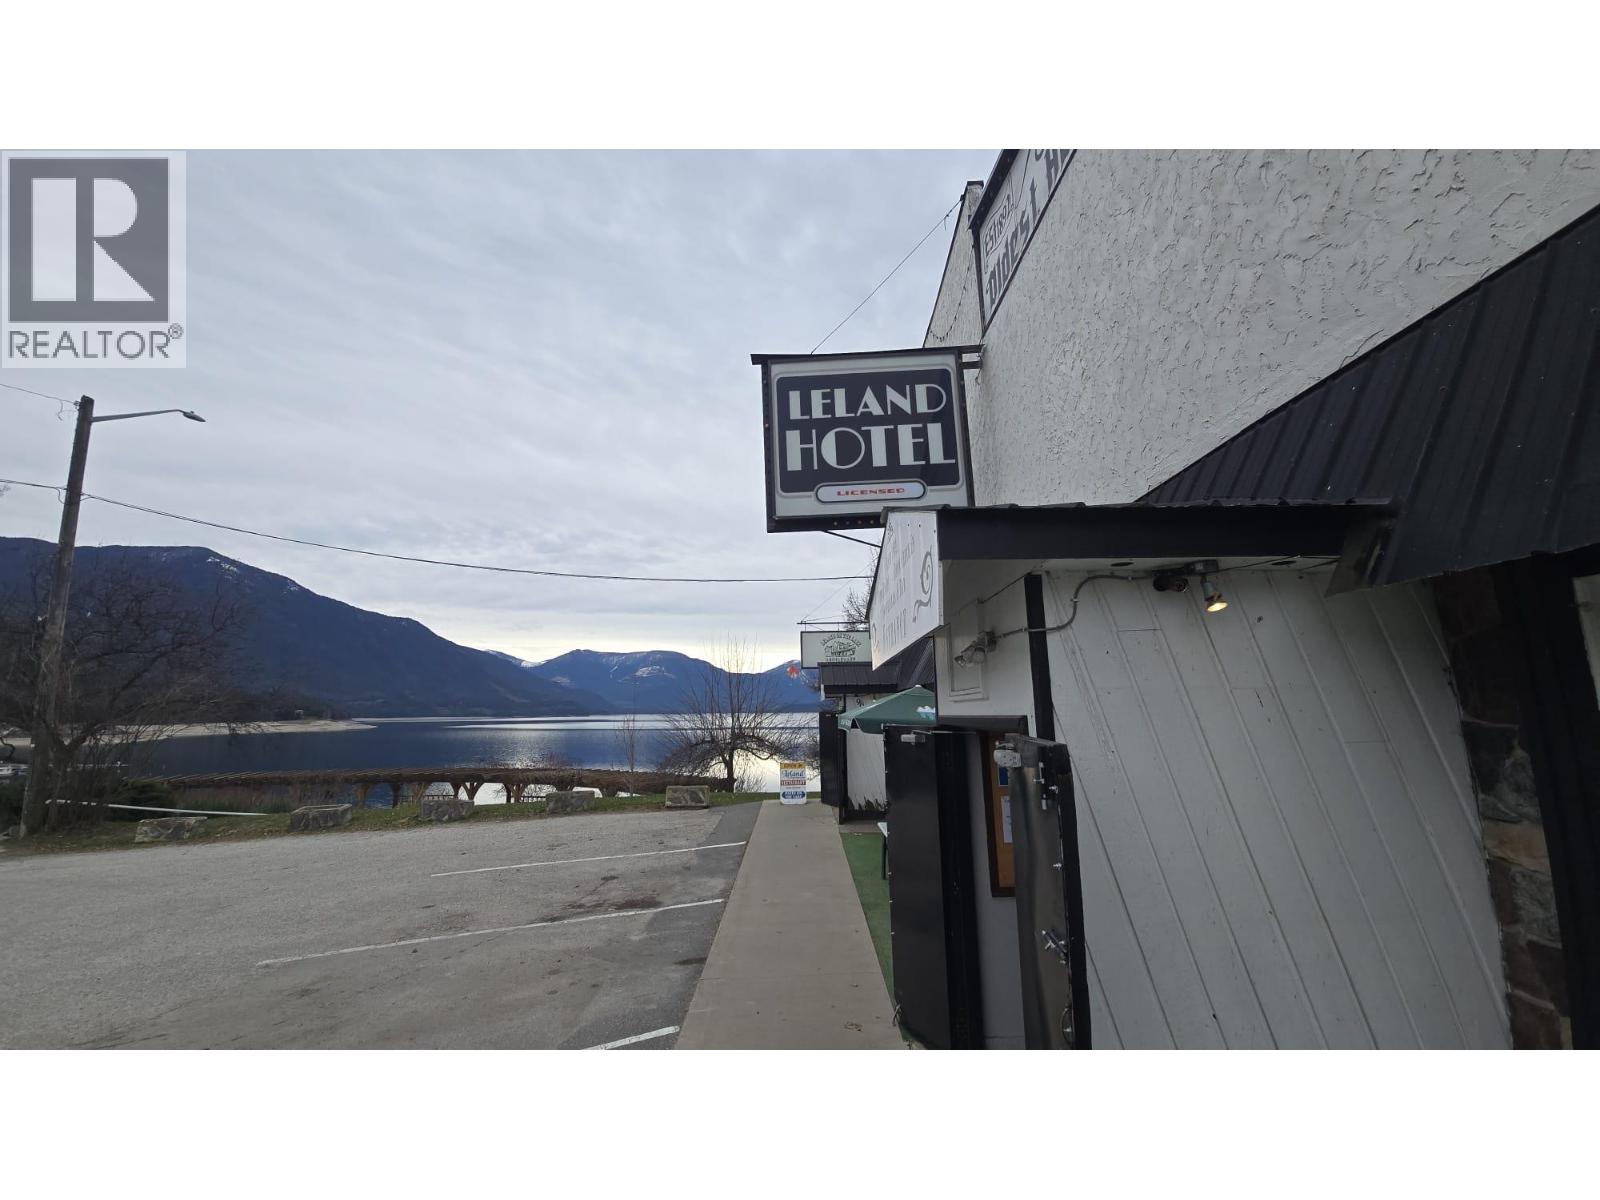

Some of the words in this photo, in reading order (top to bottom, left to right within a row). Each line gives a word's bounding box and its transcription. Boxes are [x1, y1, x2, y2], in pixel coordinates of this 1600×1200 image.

[788, 383, 947, 421] LELAND
[785, 422, 956, 472] HOTEL
[836, 486, 906, 497] LICENSED
